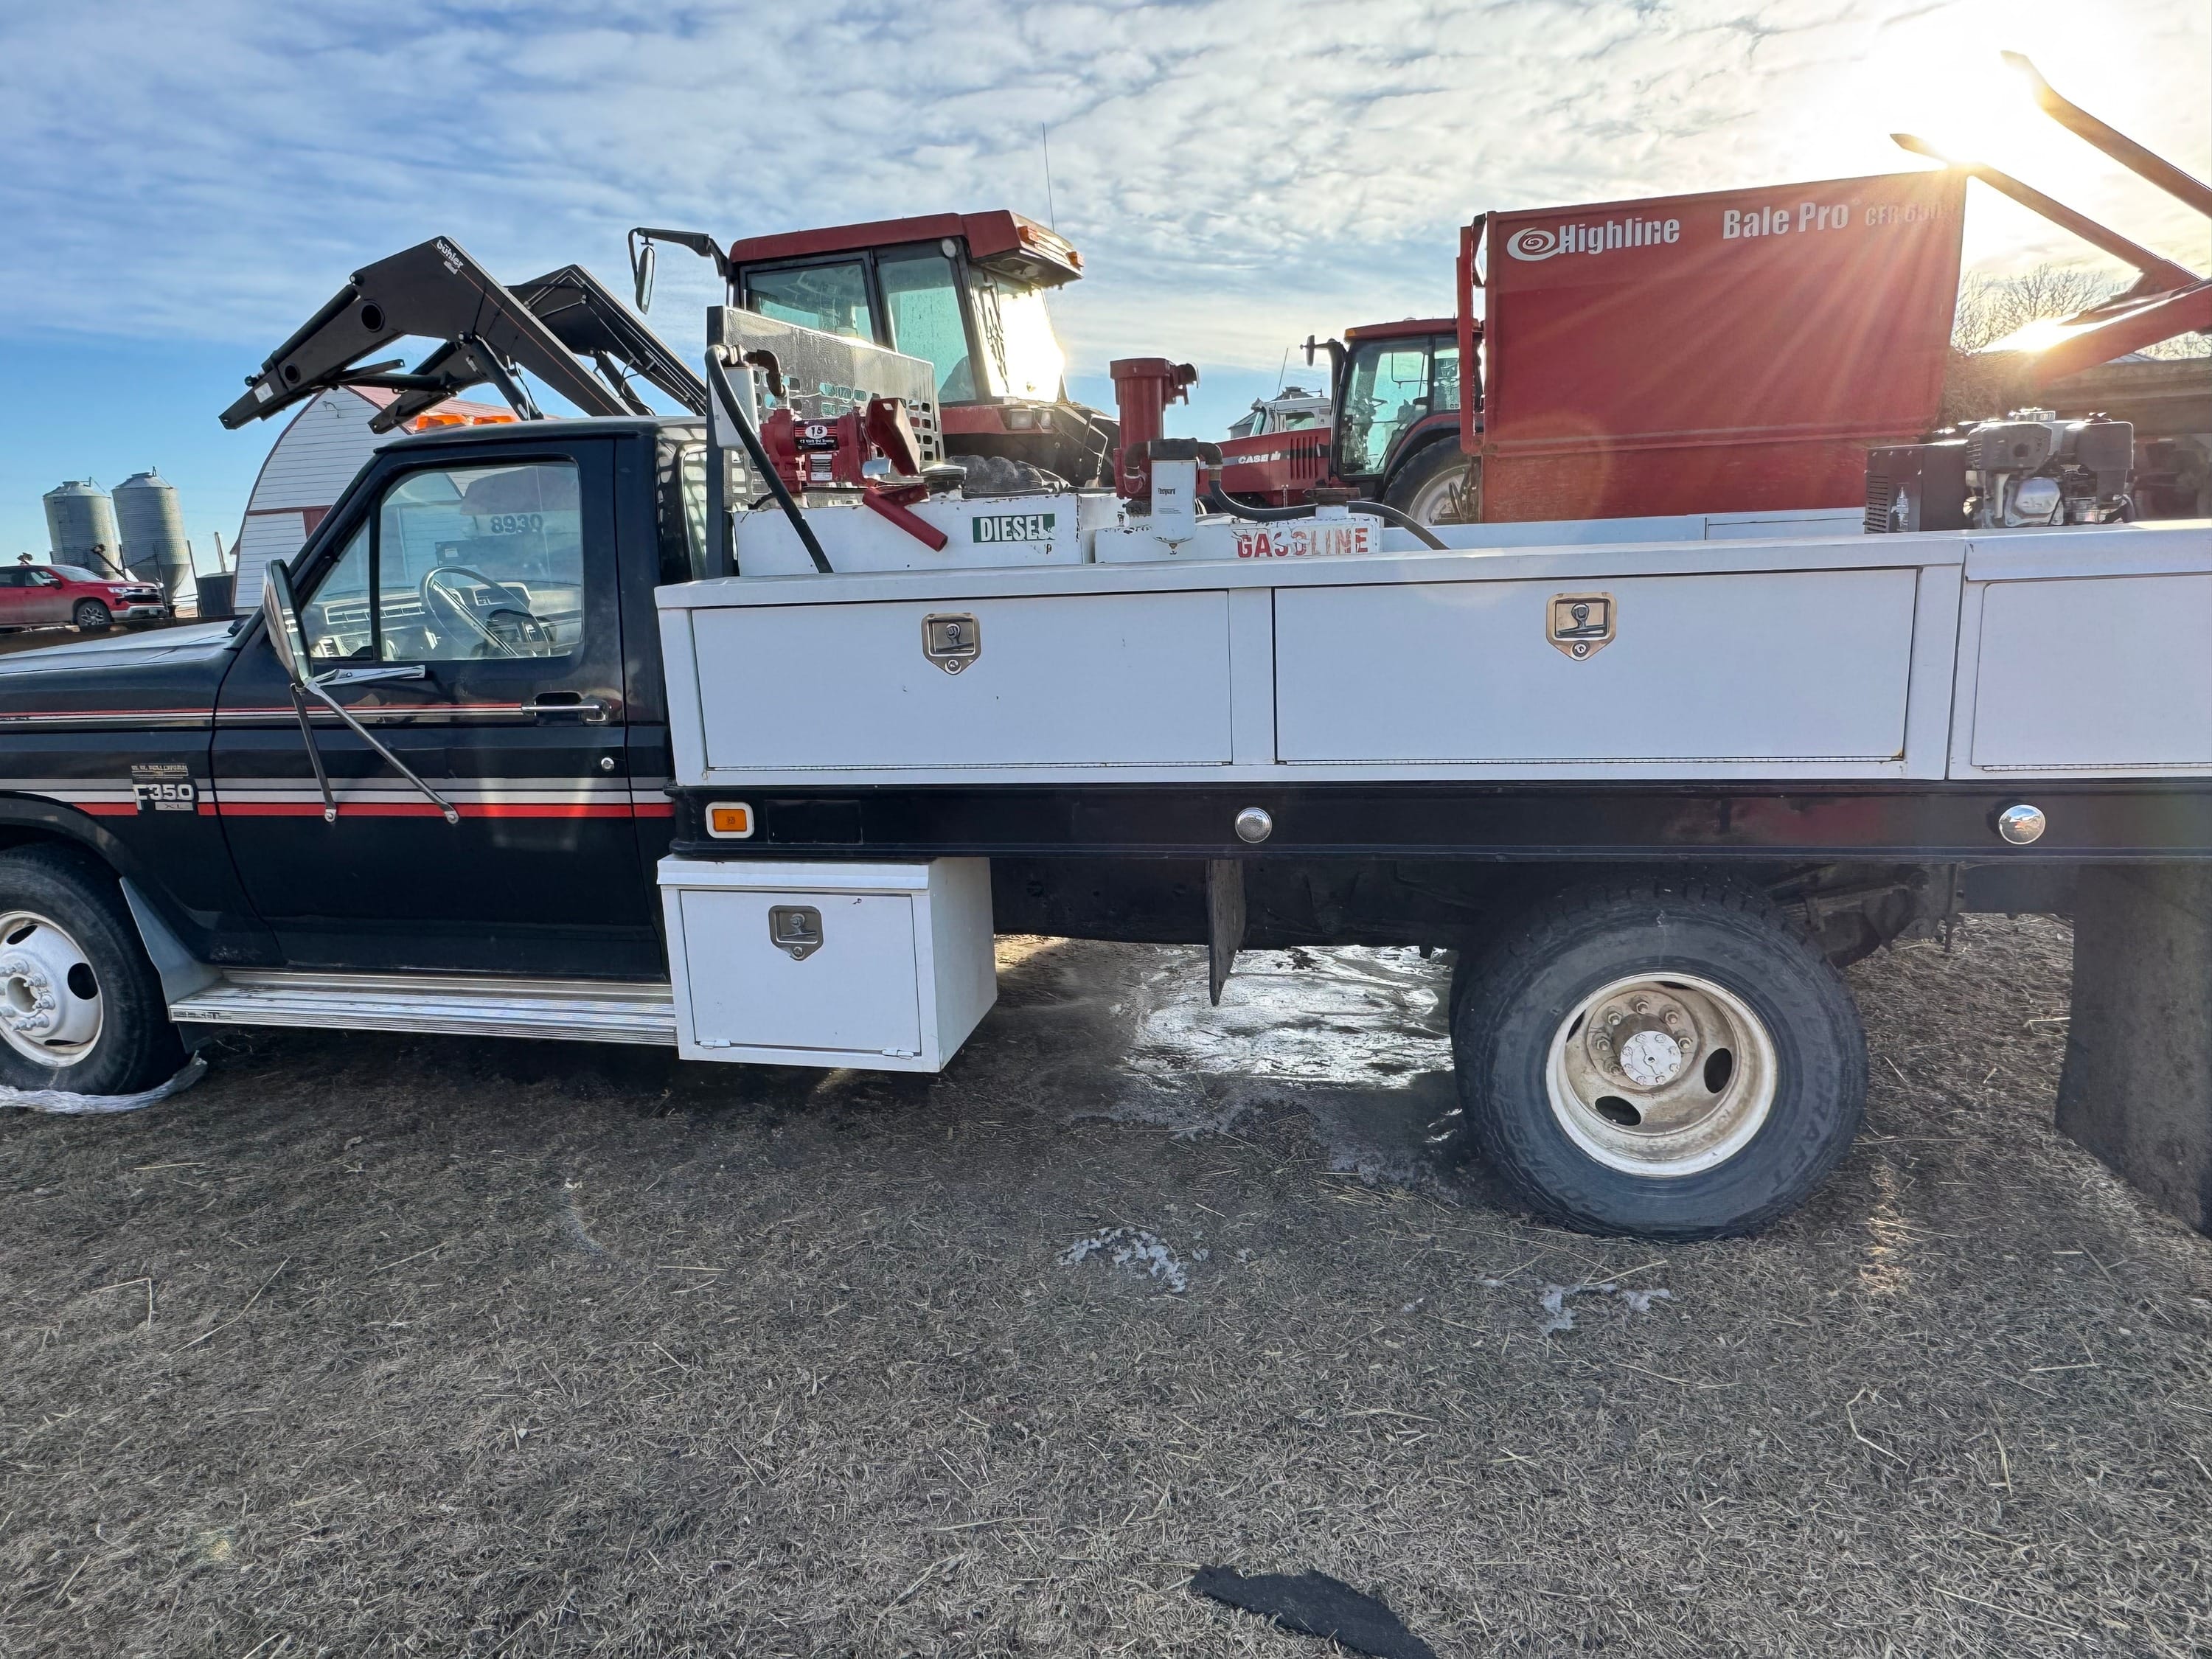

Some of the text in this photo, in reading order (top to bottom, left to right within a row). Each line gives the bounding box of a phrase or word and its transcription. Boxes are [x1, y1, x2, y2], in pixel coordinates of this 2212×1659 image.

[1559, 218, 1680, 254] Highline
[1723, 206, 1790, 240] Bale
[1798, 202, 1849, 232] Pro
[1238, 453, 1269, 465] CASE
[980, 515, 1048, 542] DIESEL
[133, 784, 195, 810] F350
